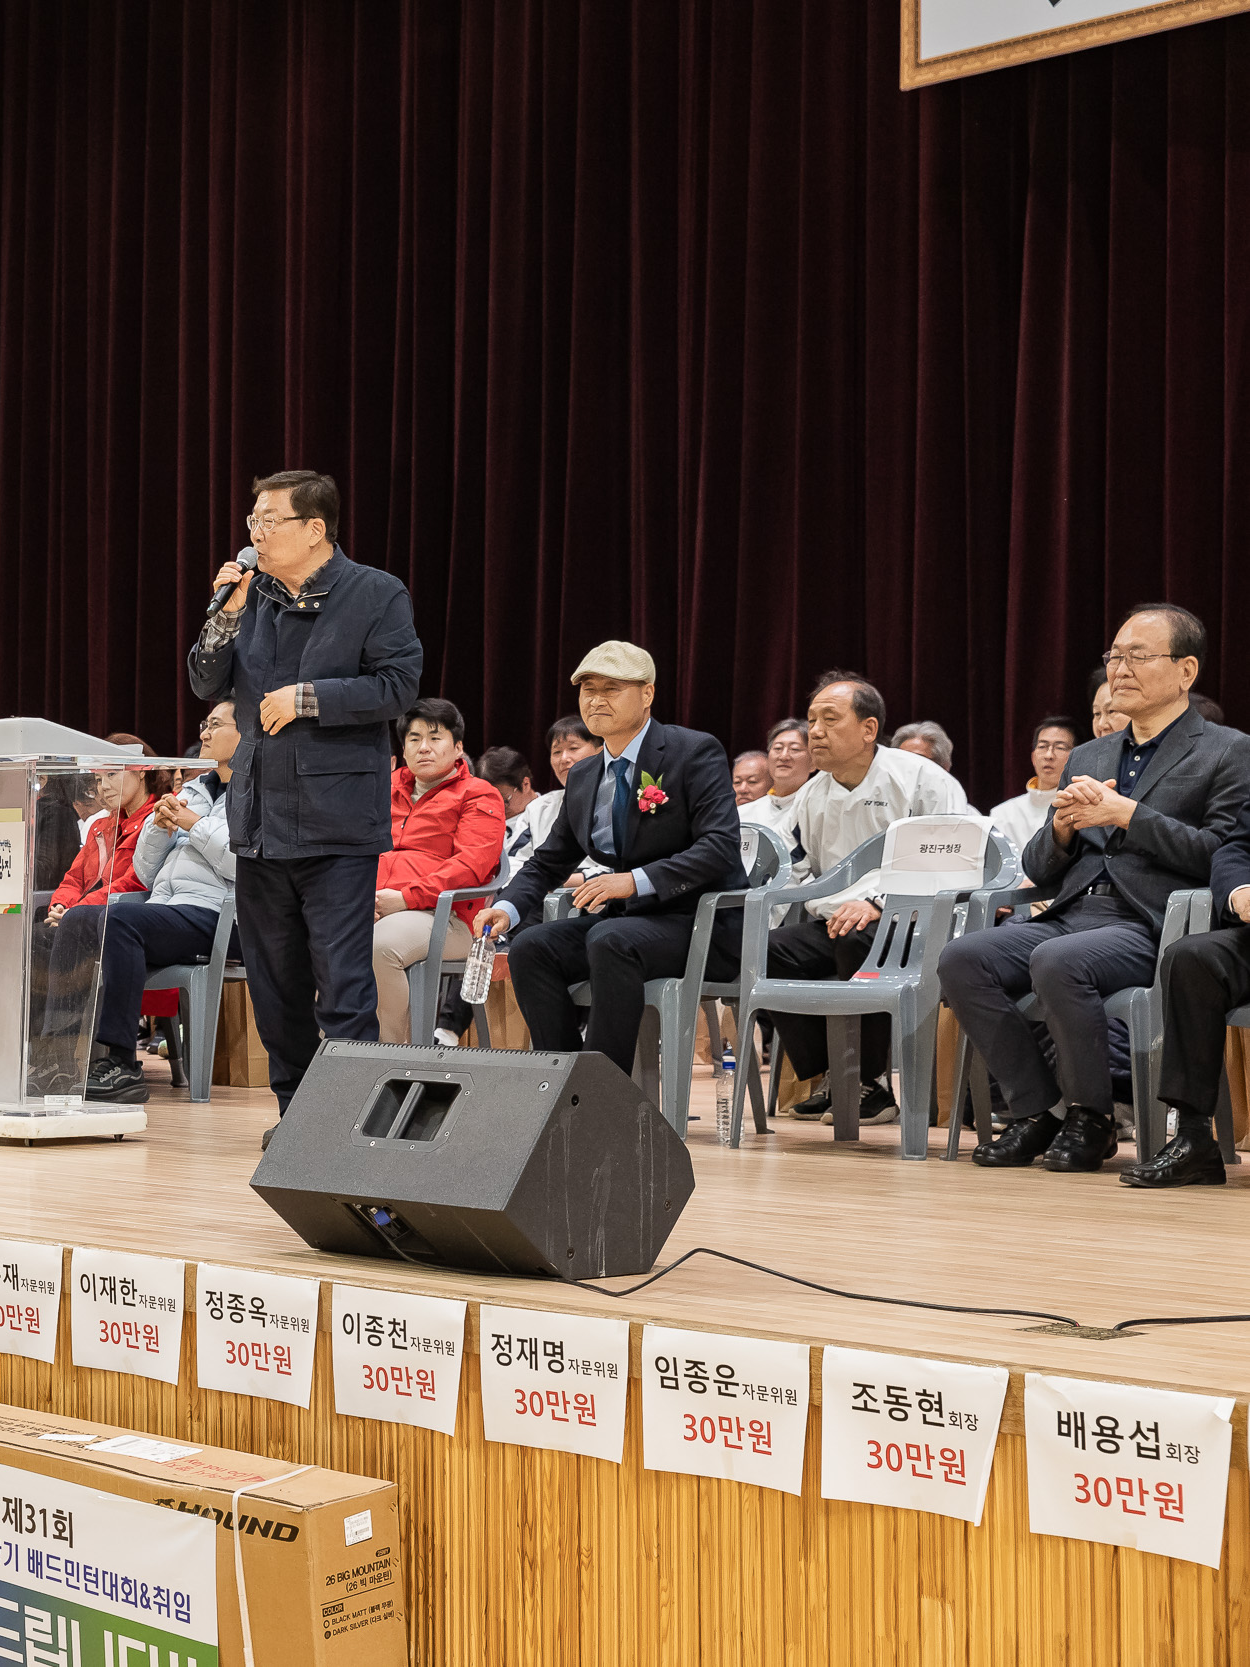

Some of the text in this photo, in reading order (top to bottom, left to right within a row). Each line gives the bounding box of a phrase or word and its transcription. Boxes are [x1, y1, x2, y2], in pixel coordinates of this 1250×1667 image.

[919, 843, 962, 854] 광진구청장
[21, 1279, 54, 1295] 자문위원
[81, 1274, 175, 1312] 이재한 자문위원
[206, 1291, 309, 1333] 정종옥 자문위원
[100, 1320, 159, 1353] 30만원
[343, 1313, 454, 1356] 이종천 자문위원
[226, 1341, 291, 1375] 30만원
[491, 1334, 617, 1379] 정재명 자문위원
[363, 1365, 435, 1400] 30만원
[655, 1356, 797, 1405] 임종운 자문위원
[515, 1389, 596, 1426] 30만원
[852, 1383, 978, 1431] 조동현 회장
[684, 1414, 771, 1455] 30만원
[1057, 1411, 1200, 1464] 배용섭 회장
[868, 1440, 966, 1485] 30만원
[1075, 1473, 1184, 1522] 30만원
[2, 1496, 73, 1549] 제31회
[27, 1548, 191, 1625] 배드민턴대회&취임
[326, 1558, 391, 1586] 26 BIG MOUNTAIN
[346, 1581, 358, 1593] (26
[323, 1604, 343, 1616] COLOR
[331, 1613, 351, 1626] BLACK
[352, 1608, 367, 1619] MATT
[332, 1626, 348, 1636] DARK
[349, 1619, 369, 1631] SILVER
